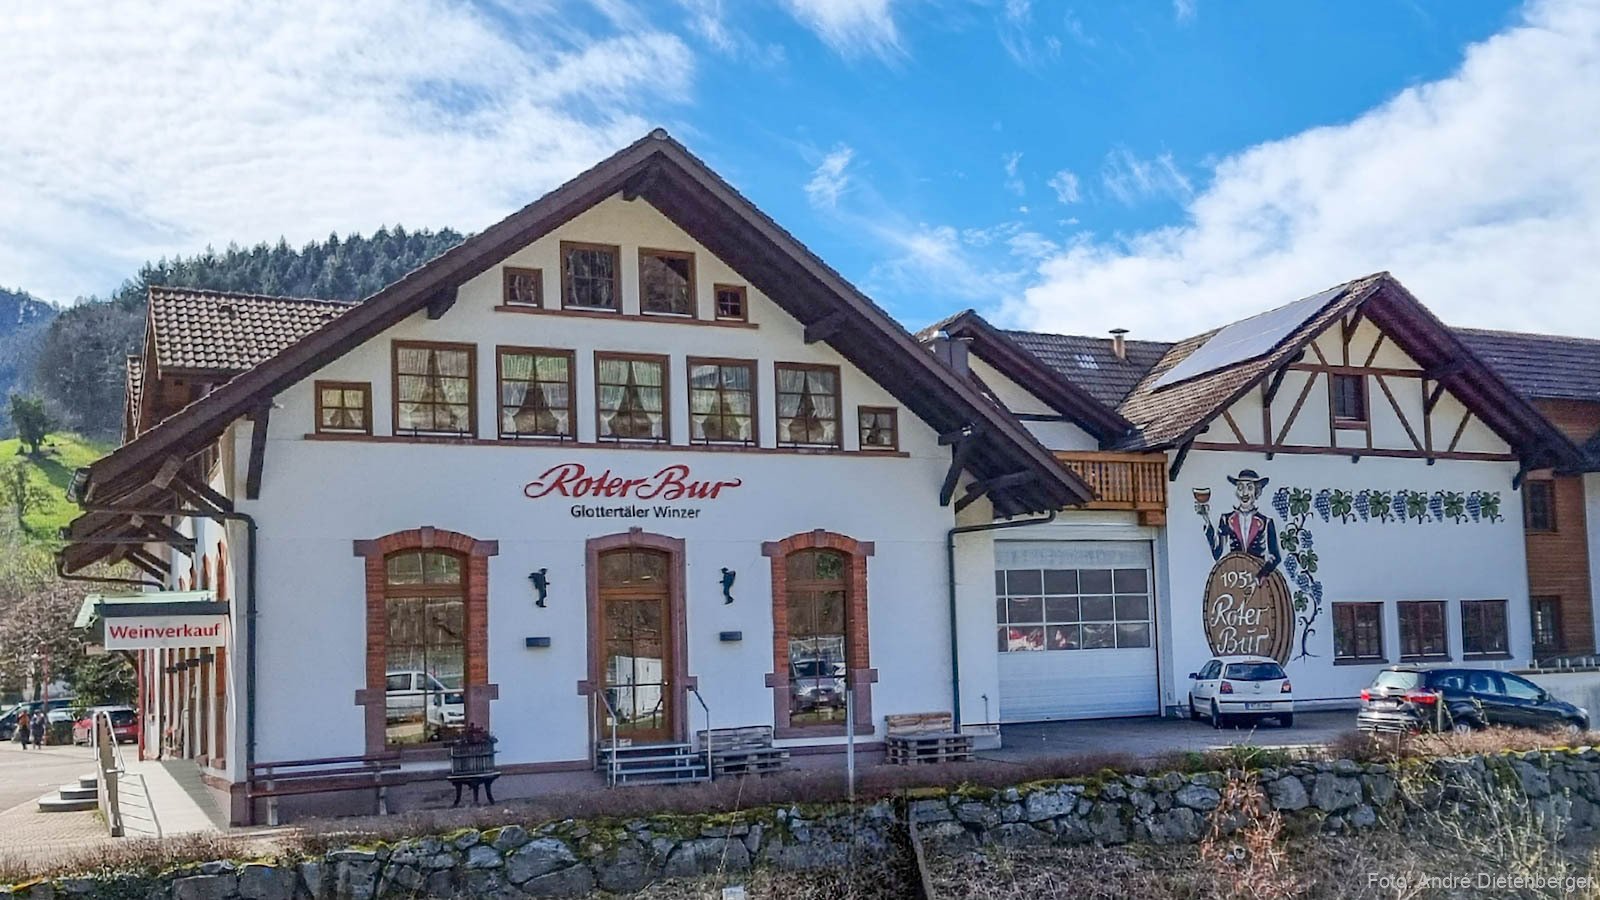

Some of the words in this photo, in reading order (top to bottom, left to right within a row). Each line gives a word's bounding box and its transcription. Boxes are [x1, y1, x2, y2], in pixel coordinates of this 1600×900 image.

[525, 463, 647, 498] Roter
[636, 464, 742, 500] Bur
[571, 504, 649, 518] Glottertäler
[653, 505, 701, 518] Winzer
[1211, 594, 1269, 626] Roter
[109, 622, 221, 639] Weinverkauf
